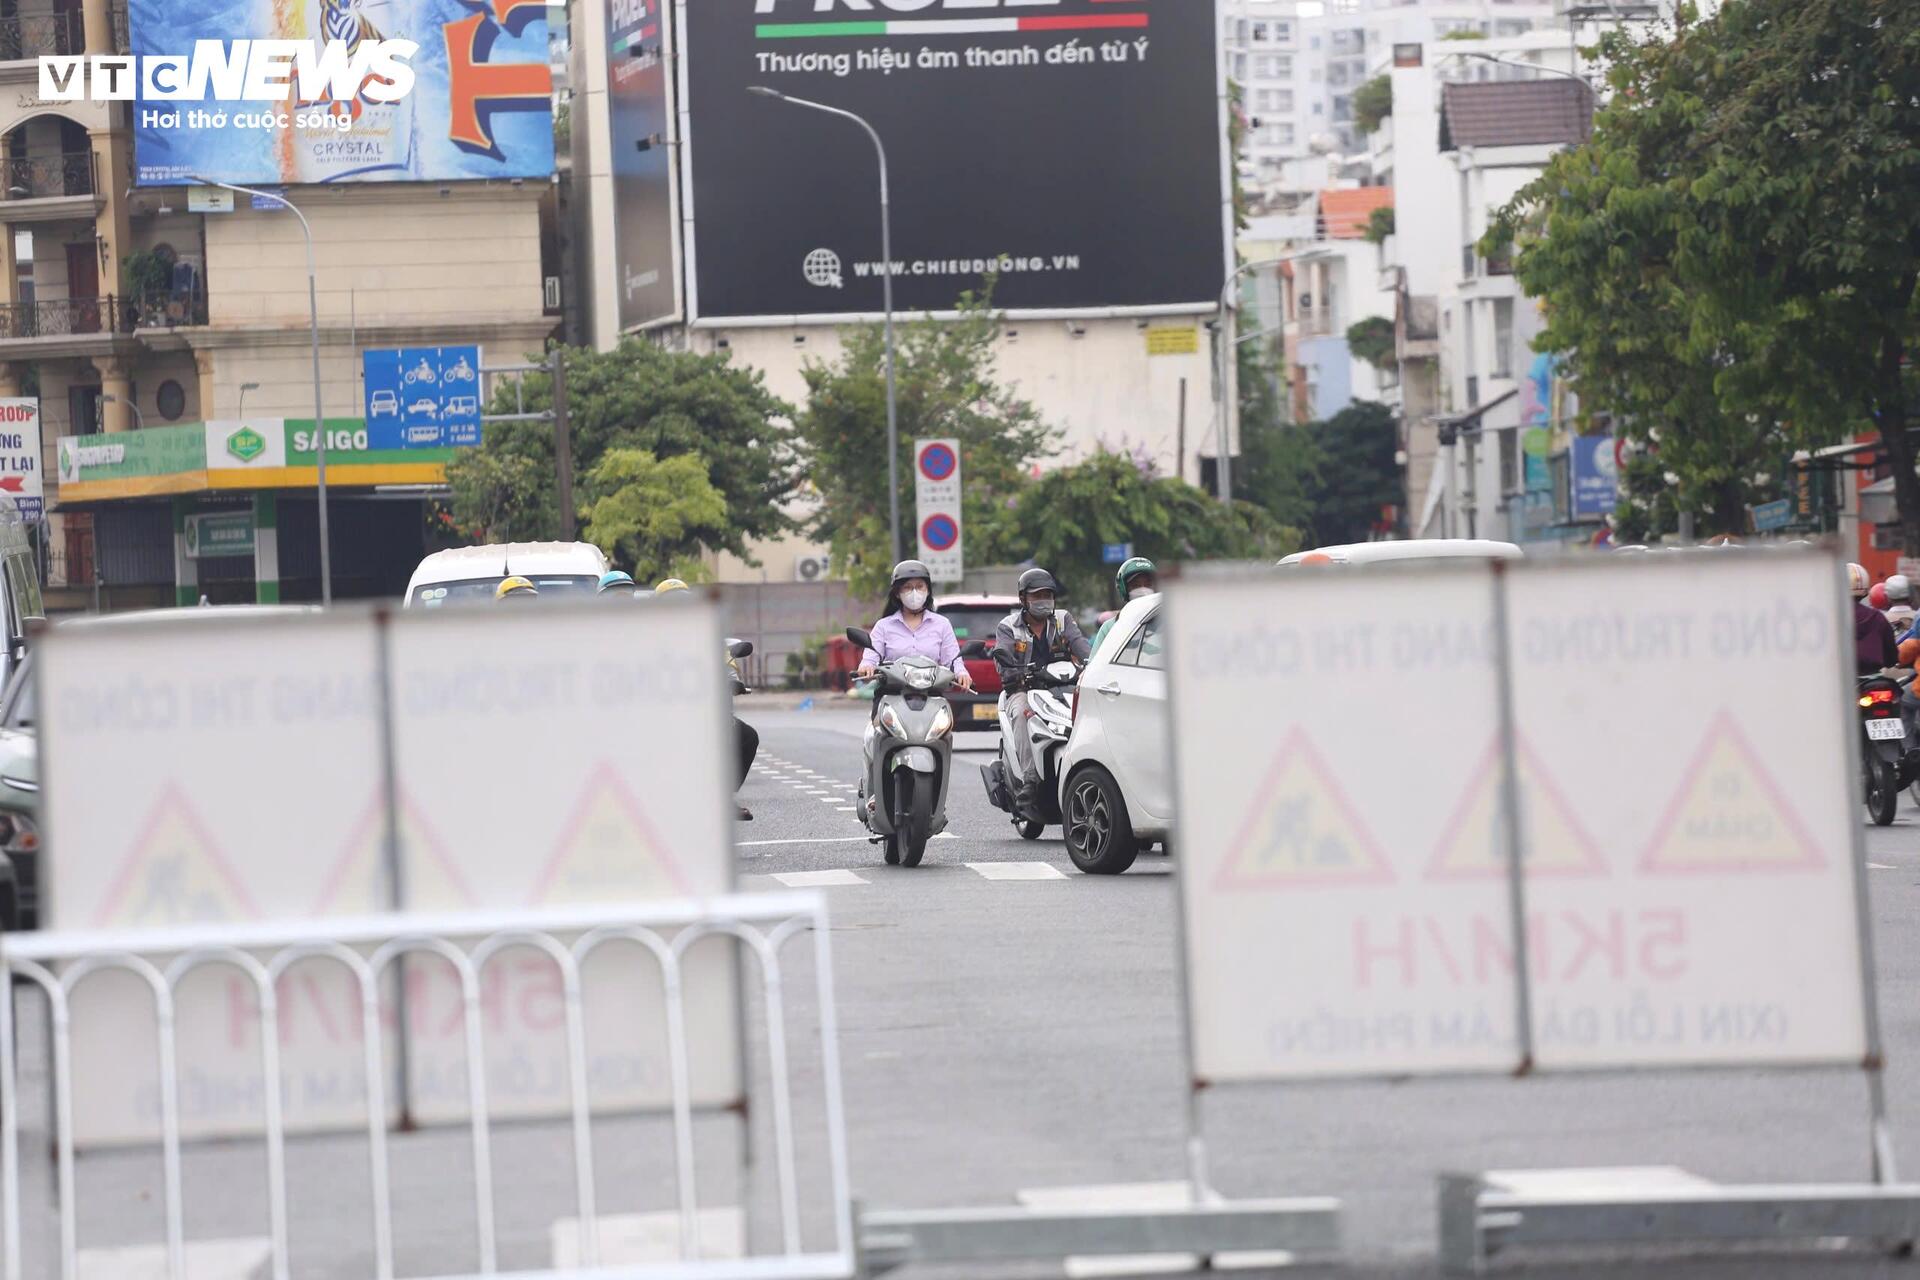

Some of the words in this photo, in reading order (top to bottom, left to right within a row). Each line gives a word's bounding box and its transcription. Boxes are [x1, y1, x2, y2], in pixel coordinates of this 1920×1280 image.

[755, 51, 850, 77] Thương
[857, 47, 911, 78] hiệu
[917, 48, 959, 69] âm
[964, 44, 1040, 67] thanh
[1045, 38, 1095, 64] đến
[1100, 39, 1129, 62] từ
[1132, 36, 1149, 61] Ý
[313, 142, 384, 156] CRYSTAL
